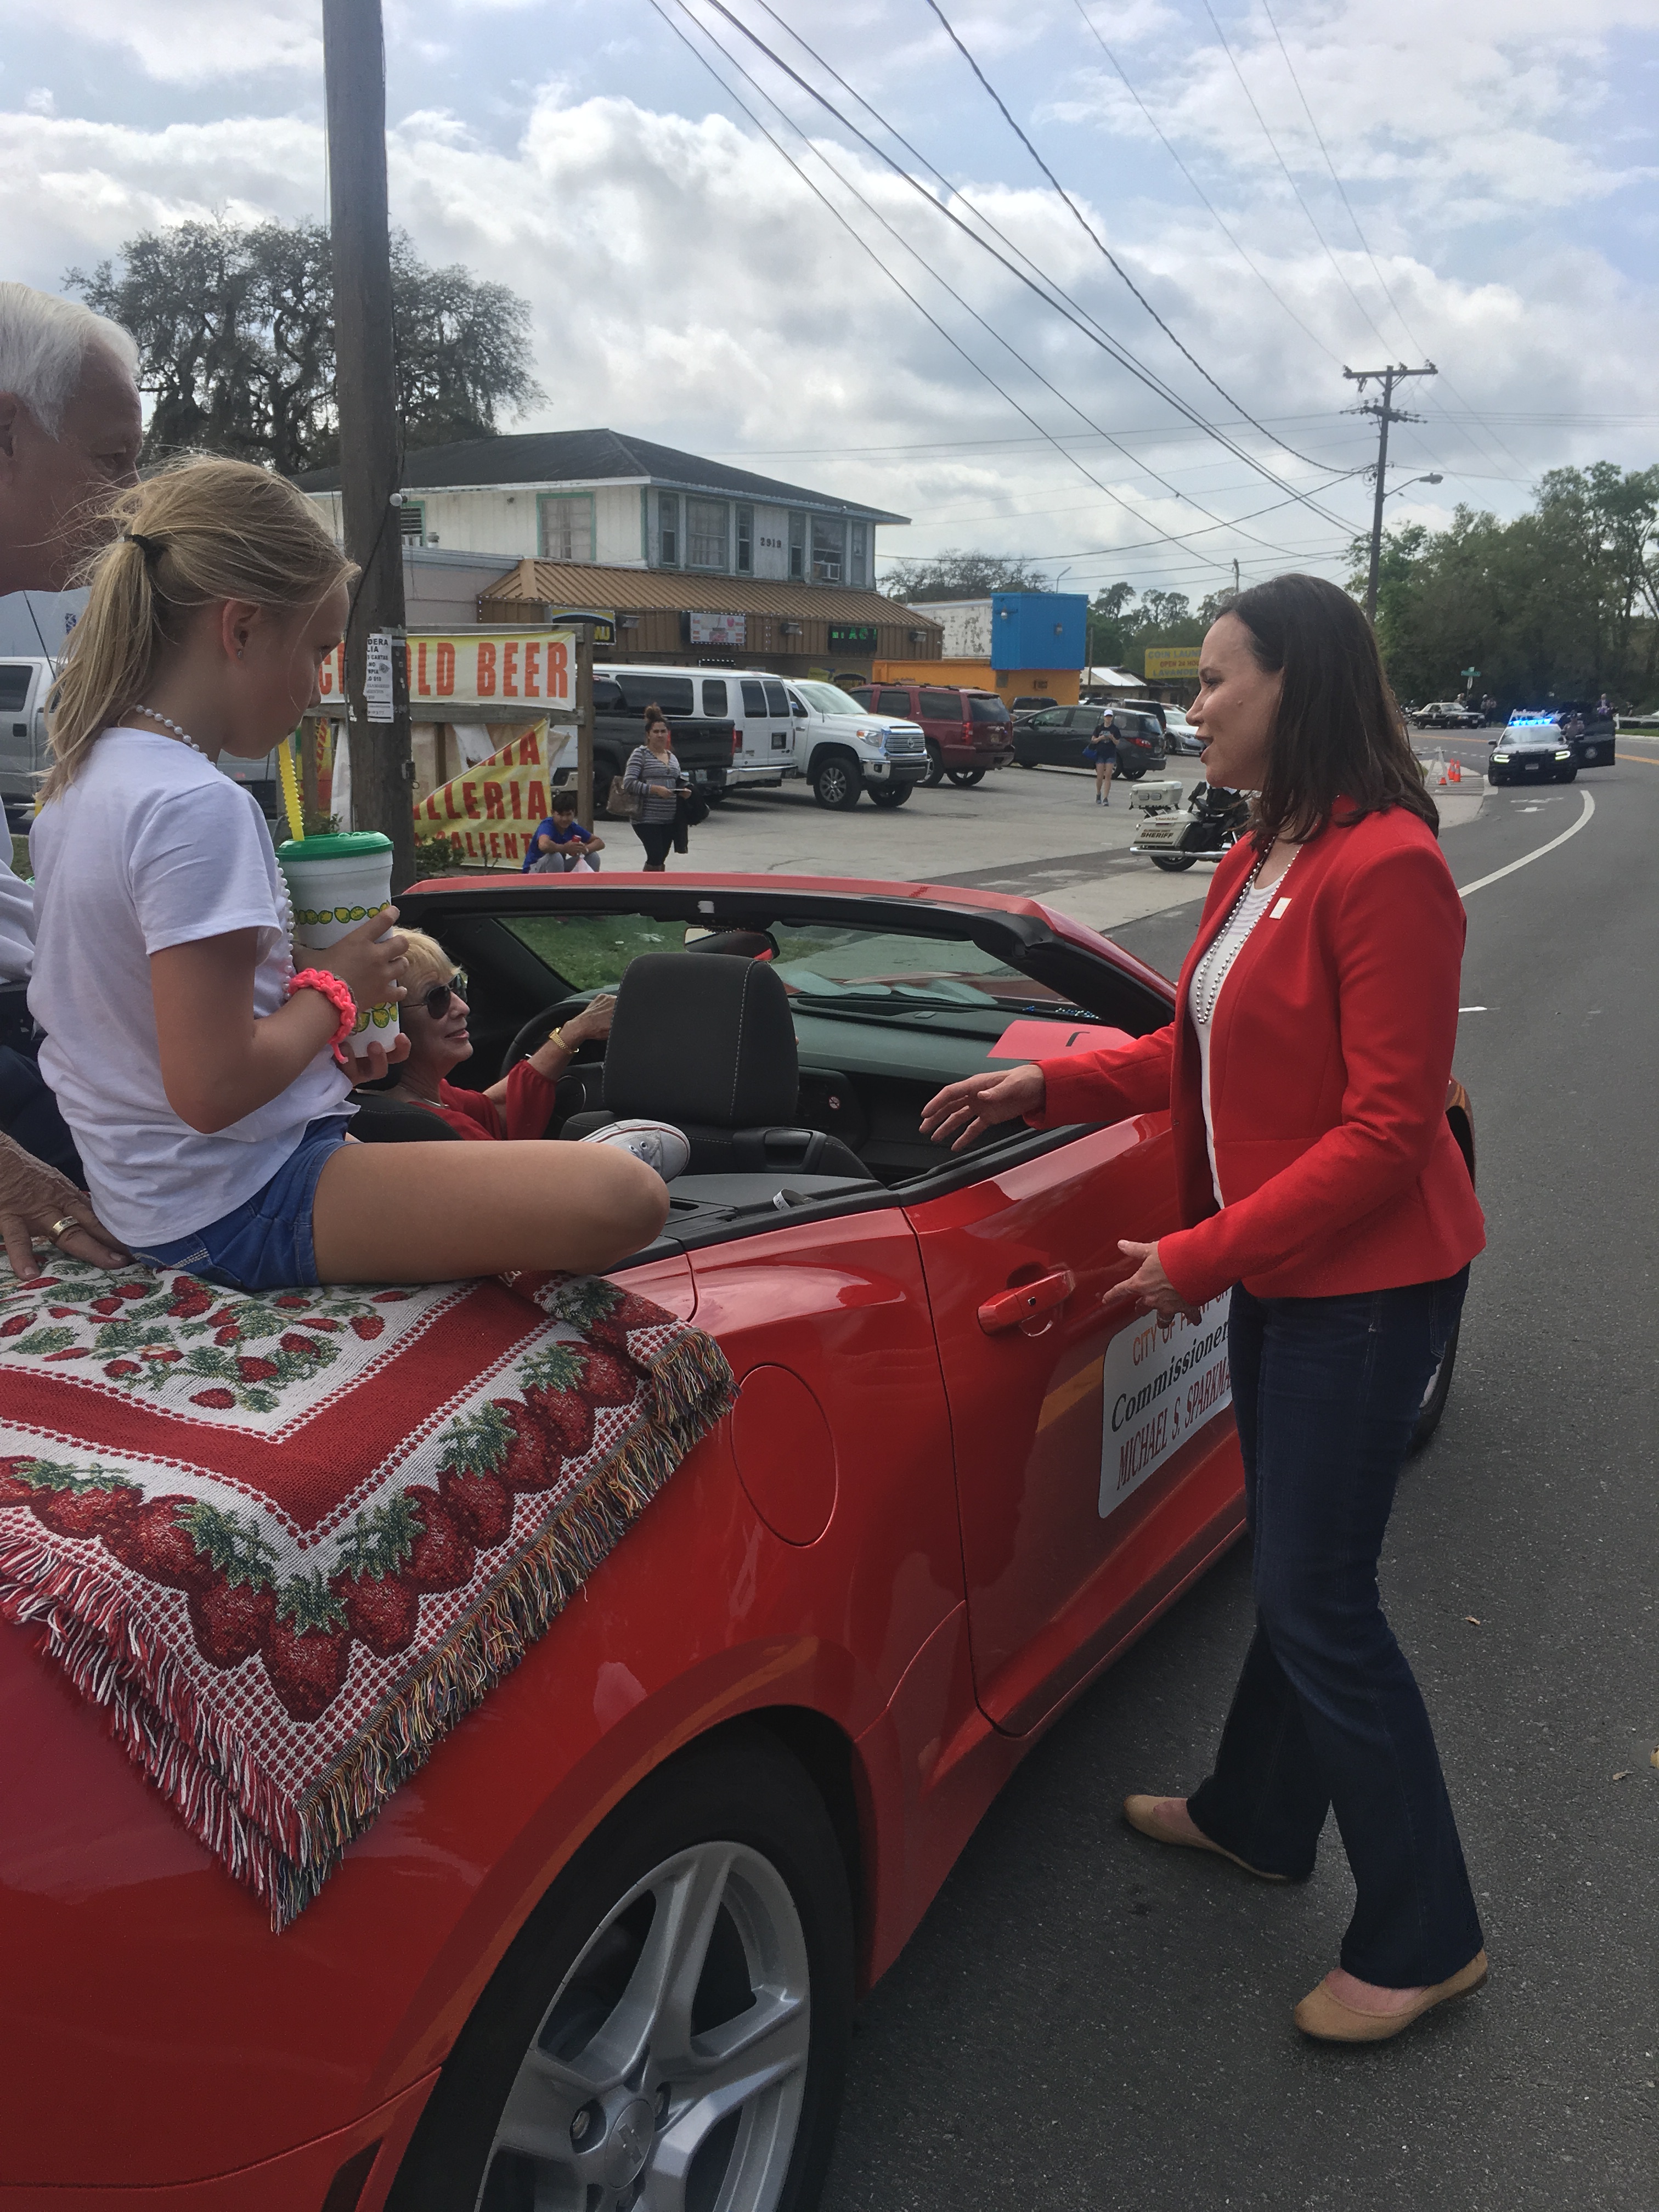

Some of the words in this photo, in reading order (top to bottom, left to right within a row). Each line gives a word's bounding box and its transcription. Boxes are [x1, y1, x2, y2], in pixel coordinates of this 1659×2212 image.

[477, 642, 568, 698] BEER
[1148, 651, 1170, 659] COIN
[1133, 1323, 1159, 1366] CITY
[1111, 1321, 1229, 1432] Commissioner
[1117, 1407, 1168, 1491] MICHAEL
[1172, 1396, 1181, 1440] S.
